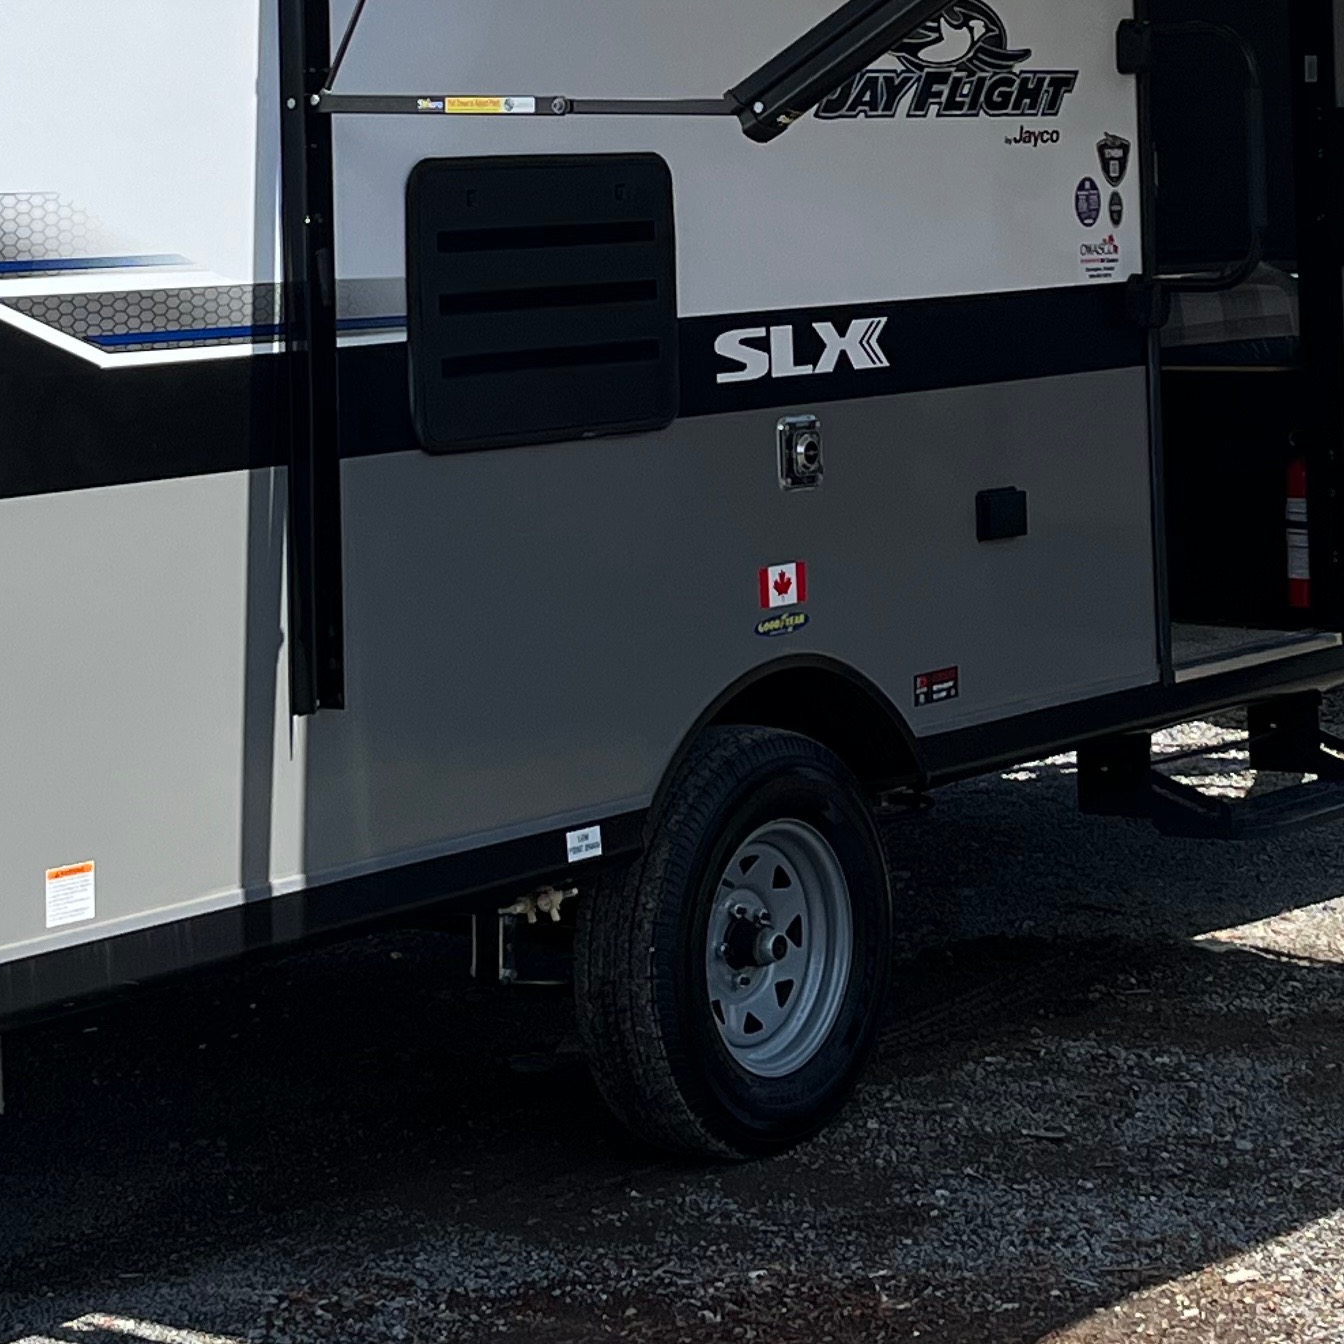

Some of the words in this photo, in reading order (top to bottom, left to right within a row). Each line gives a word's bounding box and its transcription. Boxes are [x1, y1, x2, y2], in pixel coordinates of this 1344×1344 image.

[814, 68, 922, 119] JAY
[906, 67, 1079, 118] FLIGHT
[1013, 124, 1060, 147] Jayco
[713, 316, 890, 384] SLX
